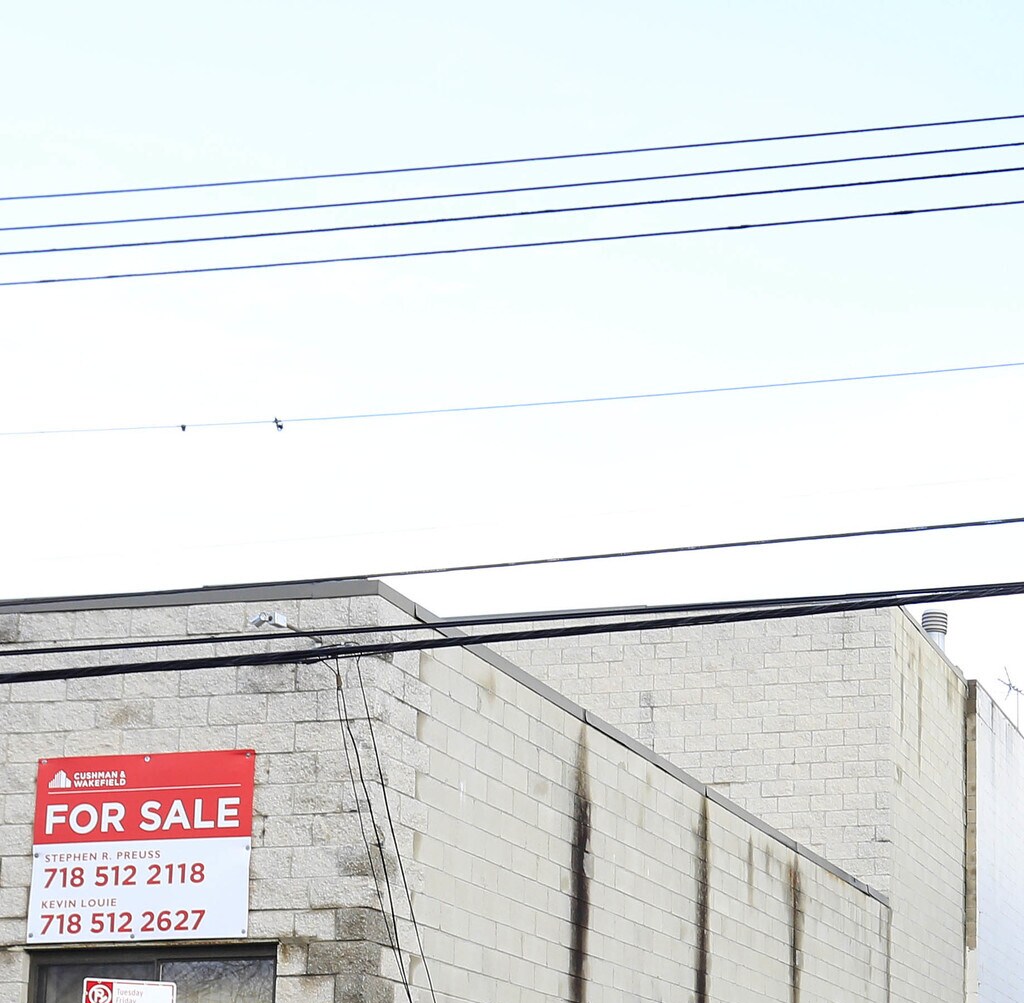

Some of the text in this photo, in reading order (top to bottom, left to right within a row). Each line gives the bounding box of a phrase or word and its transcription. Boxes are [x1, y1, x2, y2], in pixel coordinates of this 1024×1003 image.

[74, 770, 126, 780] CUSHMAN &
[74, 779, 126, 787] WAKEFIELD
[45, 797, 240, 834] FOR SALE
[45, 850, 161, 862] STEPHEN R. PREUSS
[44, 863, 205, 888] 718 512 2118
[41, 898, 117, 909] KEVIN LOUIE
[40, 910, 206, 935] 718 512 2627
[116, 988, 143, 998] Tuesday
